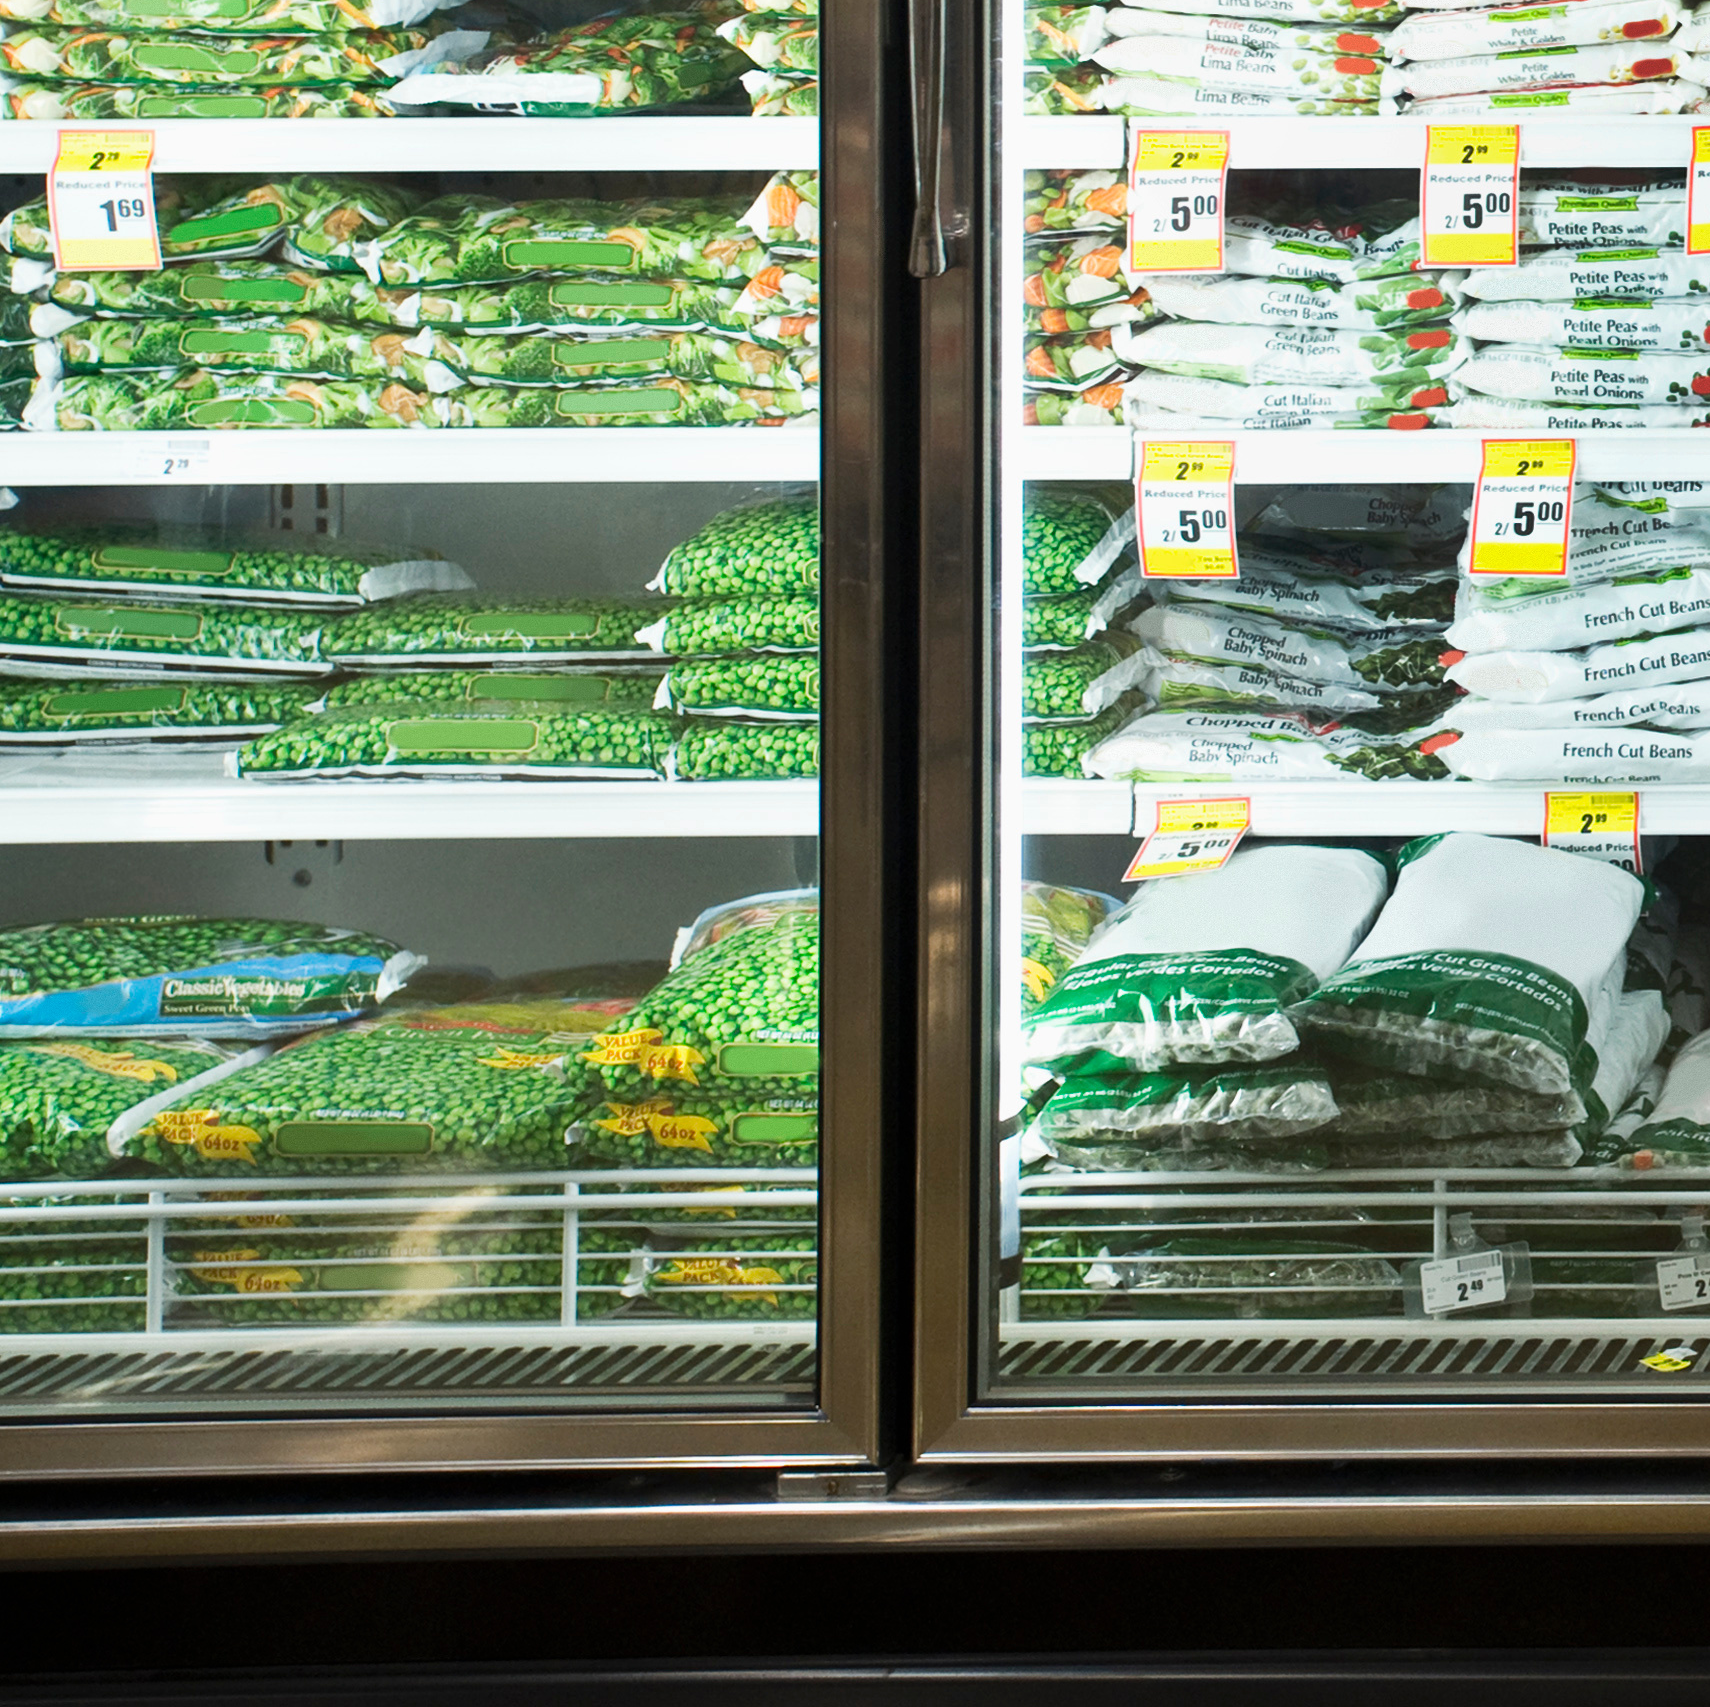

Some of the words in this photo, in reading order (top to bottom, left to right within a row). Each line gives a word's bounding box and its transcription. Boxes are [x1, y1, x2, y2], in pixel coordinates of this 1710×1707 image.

[56, 179, 111, 189] Reduced
[112, 179, 147, 189] Price
[1564, 319, 1602, 332] Petite
[1606, 320, 1638, 334] Peas
[1642, 324, 1661, 333] with
[1568, 336, 1602, 346] Pearl
[1606, 336, 1658, 346] Onions
[1584, 611, 1634, 629] French
[1227, 627, 1287, 649] Chopped
[1224, 639, 1256, 655] Baby
[1258, 642, 1307, 667] Spinach
[1563, 743, 1613, 758] French
[1649, 744, 1693, 759] Beans
[604, 1035, 647, 1046] VALUE
[607, 1048, 641, 1059] PACK
[647, 1054, 684, 1072] 64oz
[660, 1124, 697, 1140] 64oz
[204, 1133, 241, 1151] 64oz
